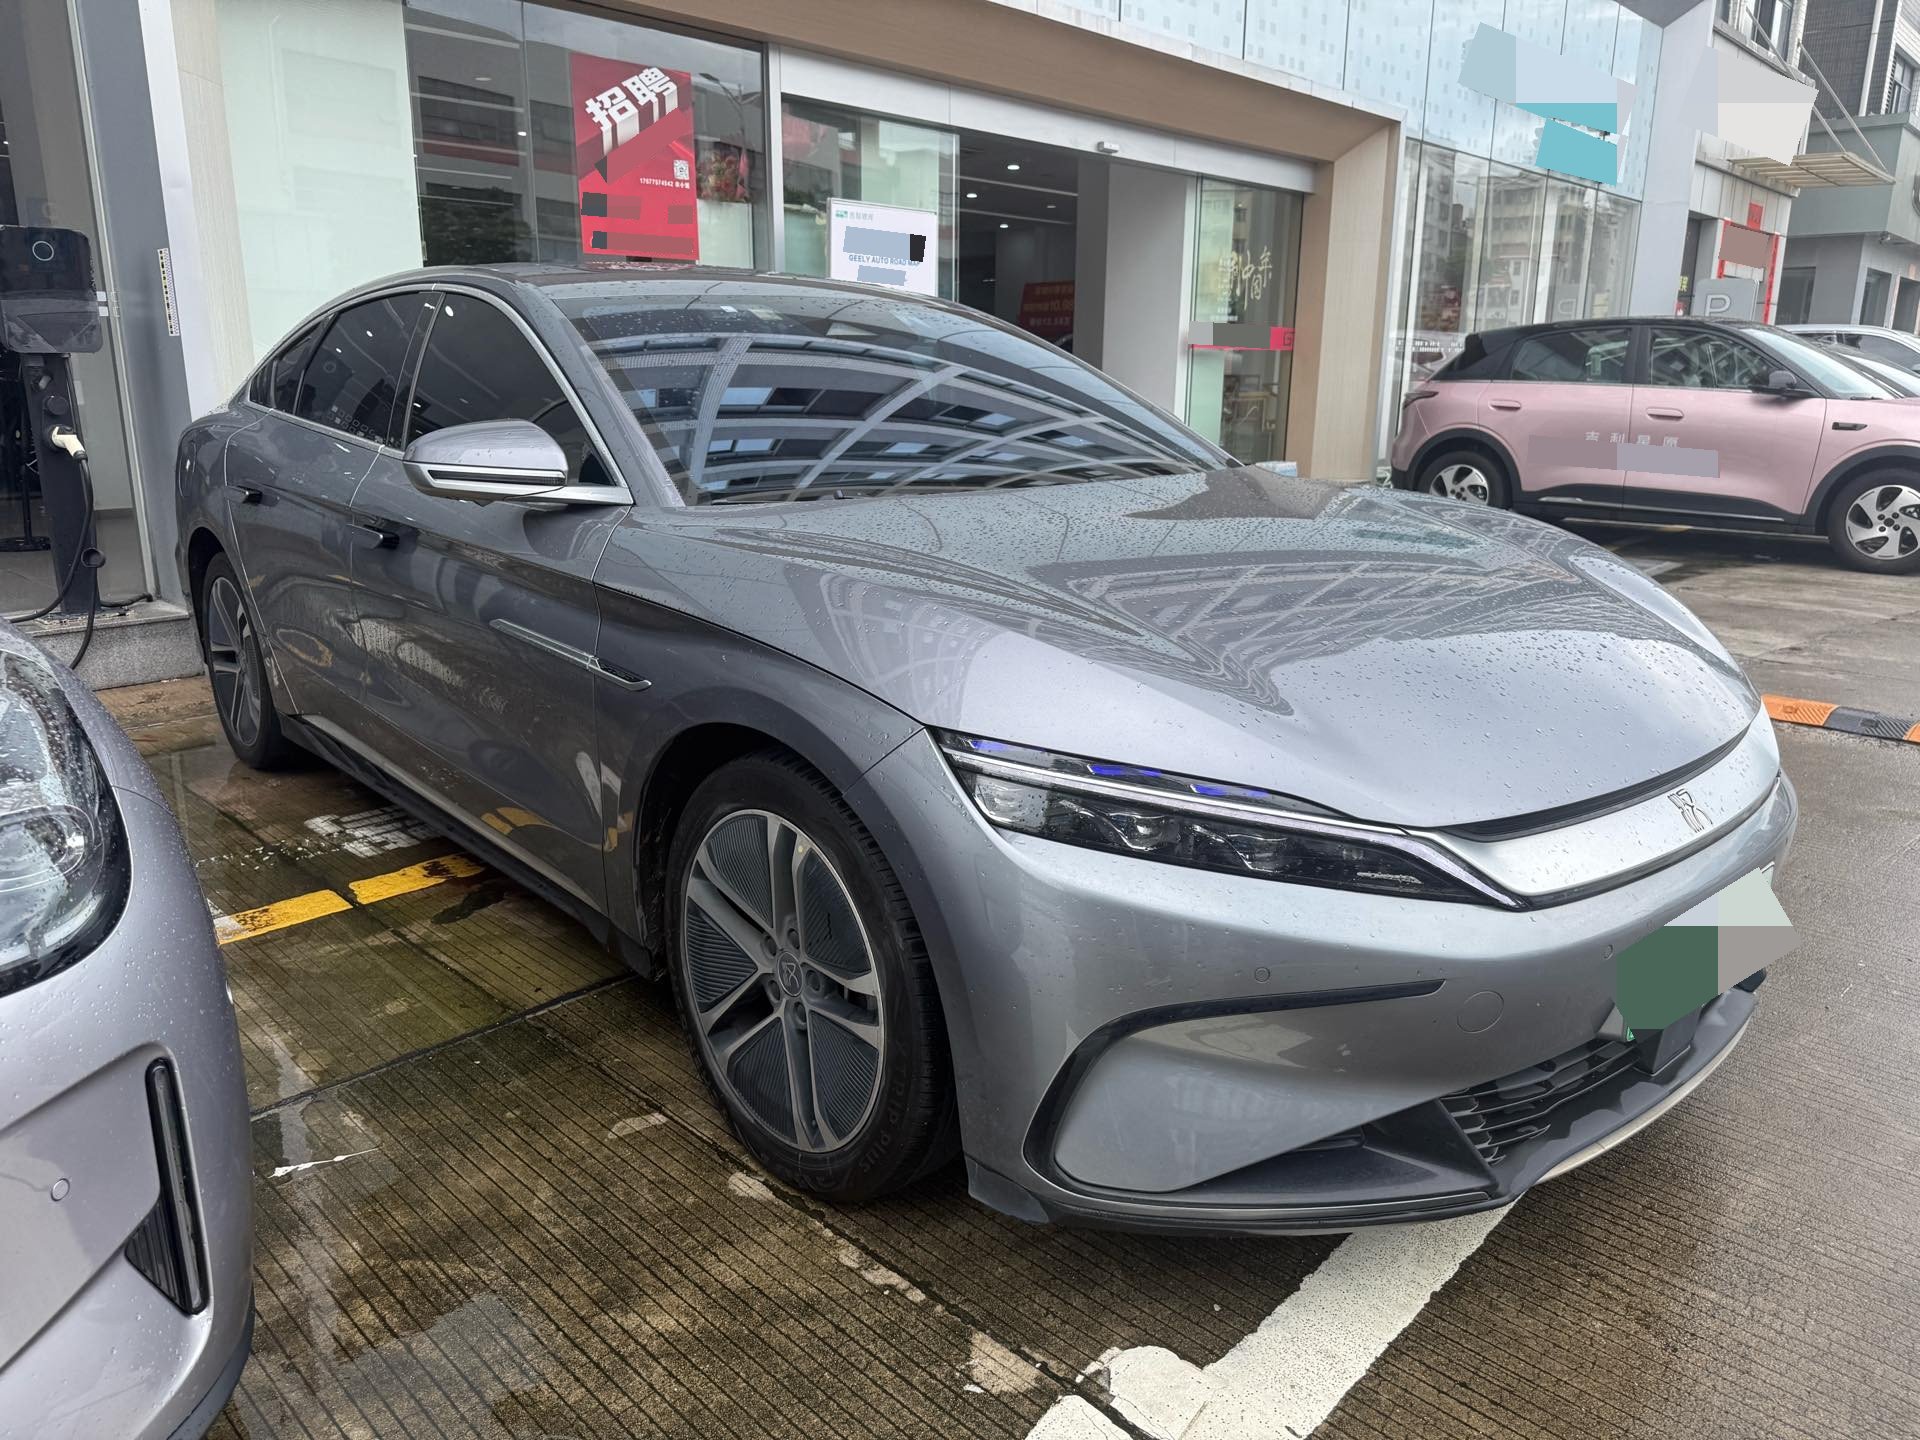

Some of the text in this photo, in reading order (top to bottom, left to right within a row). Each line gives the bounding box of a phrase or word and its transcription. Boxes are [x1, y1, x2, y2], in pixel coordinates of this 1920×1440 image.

[585, 67, 677, 135] 招聘
[849, 254, 871, 263] GEELY
[872, 256, 889, 265] AUTO
[1705, 295, 1730, 316] P
